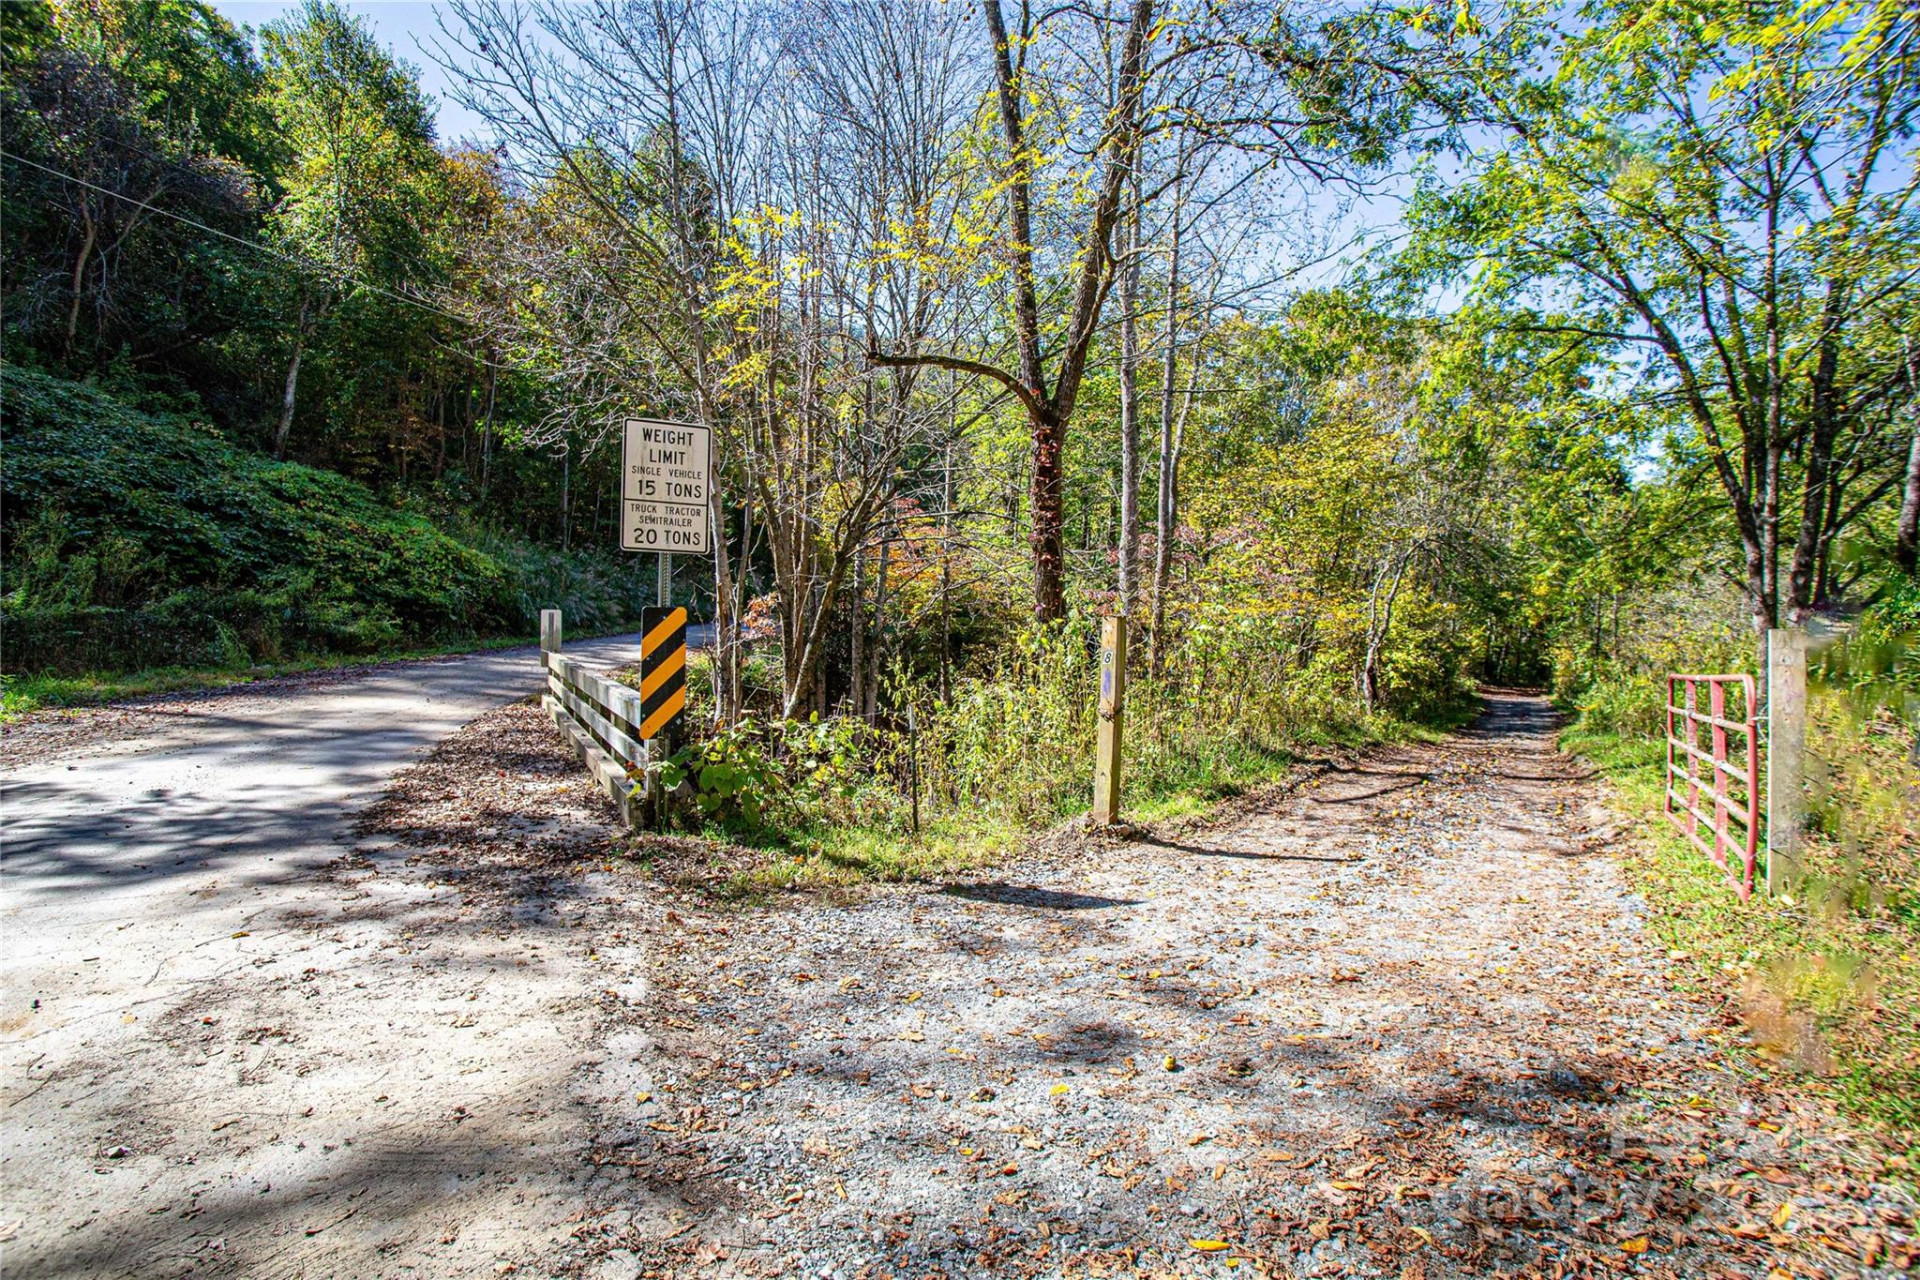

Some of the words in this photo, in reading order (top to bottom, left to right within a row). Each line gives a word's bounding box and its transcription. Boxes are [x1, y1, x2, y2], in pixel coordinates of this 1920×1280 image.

[642, 428, 694, 446] WEIGHT
[649, 449, 686, 466] LIMIT
[631, 465, 661, 476] SINGLE
[668, 469, 702, 480] VEHICLE
[638, 480, 656, 496] 15
[665, 482, 702, 499] TONS
[630, 503, 657, 514] TRUCK
[665, 506, 702, 517] TRACTOR
[638, 515, 692, 527] SEMITRAILER
[633, 528, 657, 545] 20
[664, 530, 701, 546] TONS
[1104, 652, 1112, 663] 8
